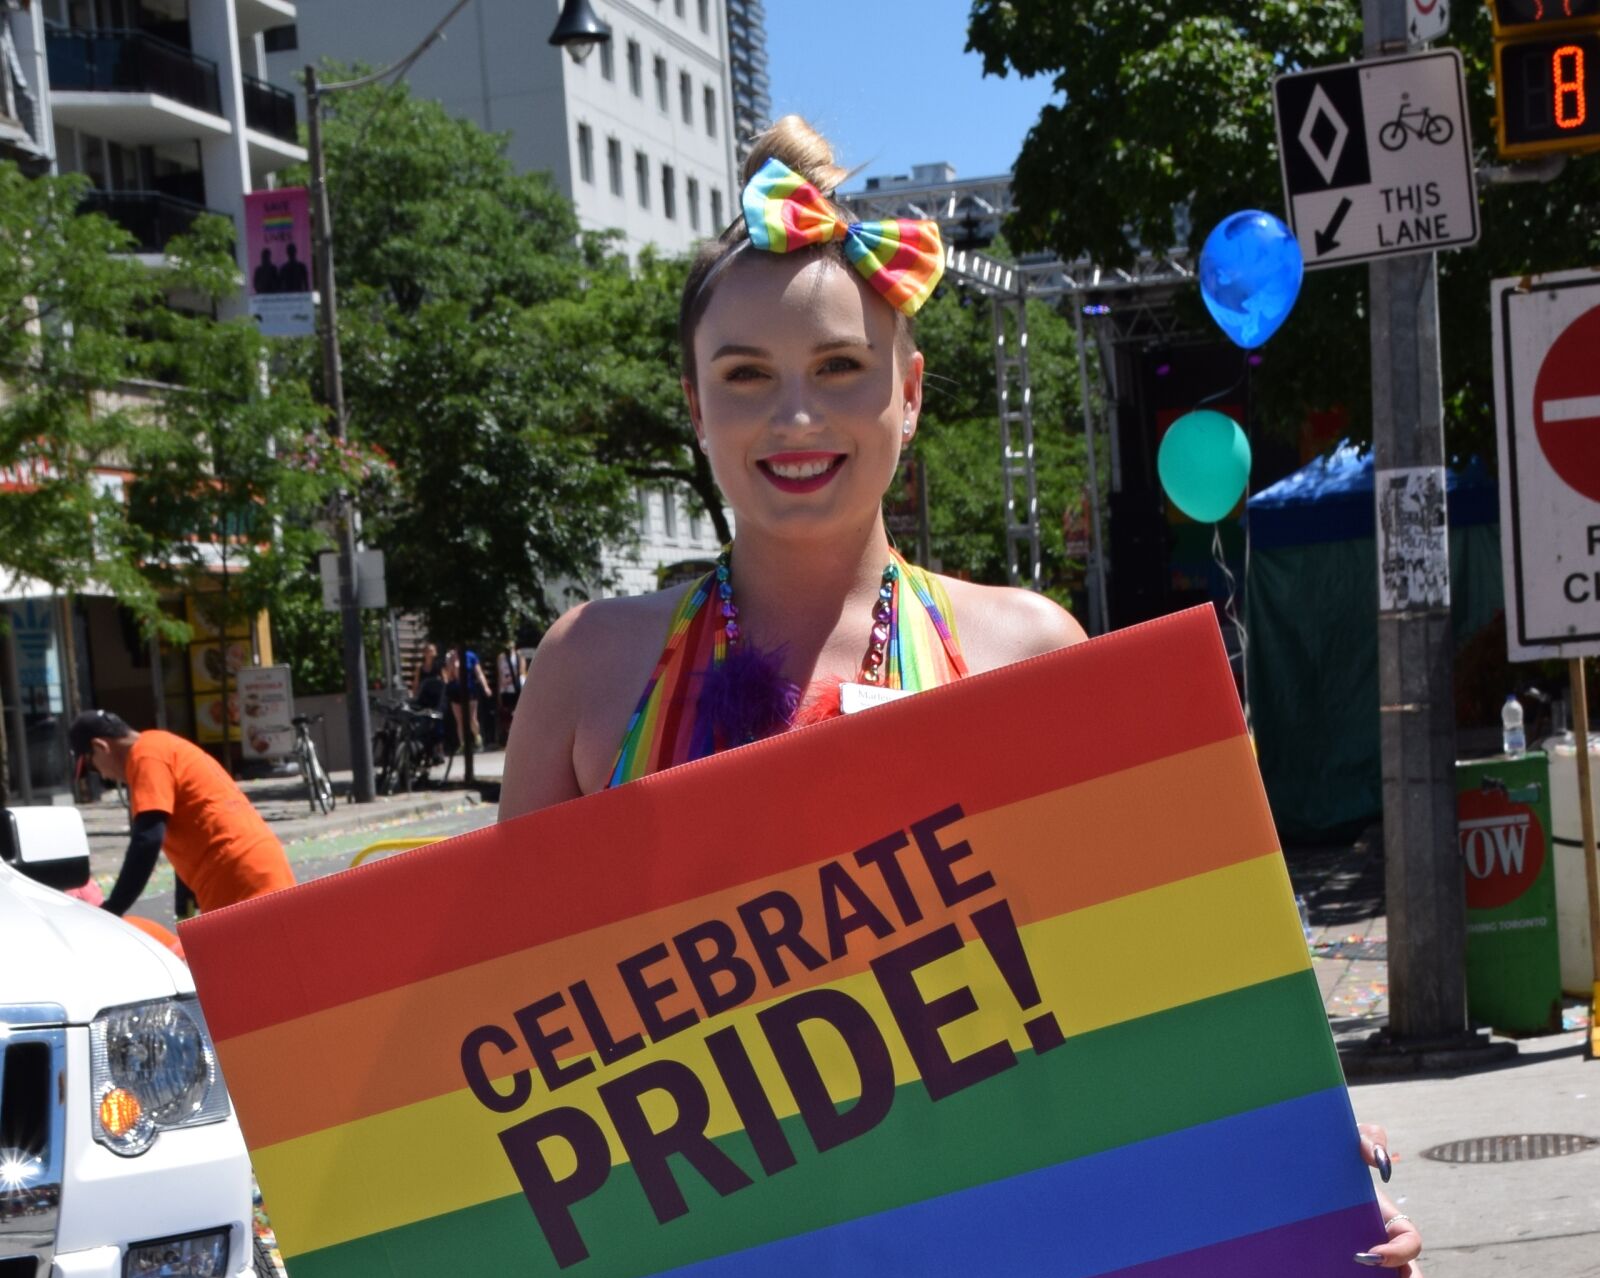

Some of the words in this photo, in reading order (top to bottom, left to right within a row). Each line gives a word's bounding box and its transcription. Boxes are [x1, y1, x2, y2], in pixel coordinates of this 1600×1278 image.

[1552, 45, 1586, 129] 8
[1377, 213, 1450, 247] LANE
[1379, 181, 1441, 213] THIS
[1459, 823, 1530, 880] OW
[459, 802, 998, 1113] CELEBRATE
[496, 898, 1067, 1270] PRIDE!
